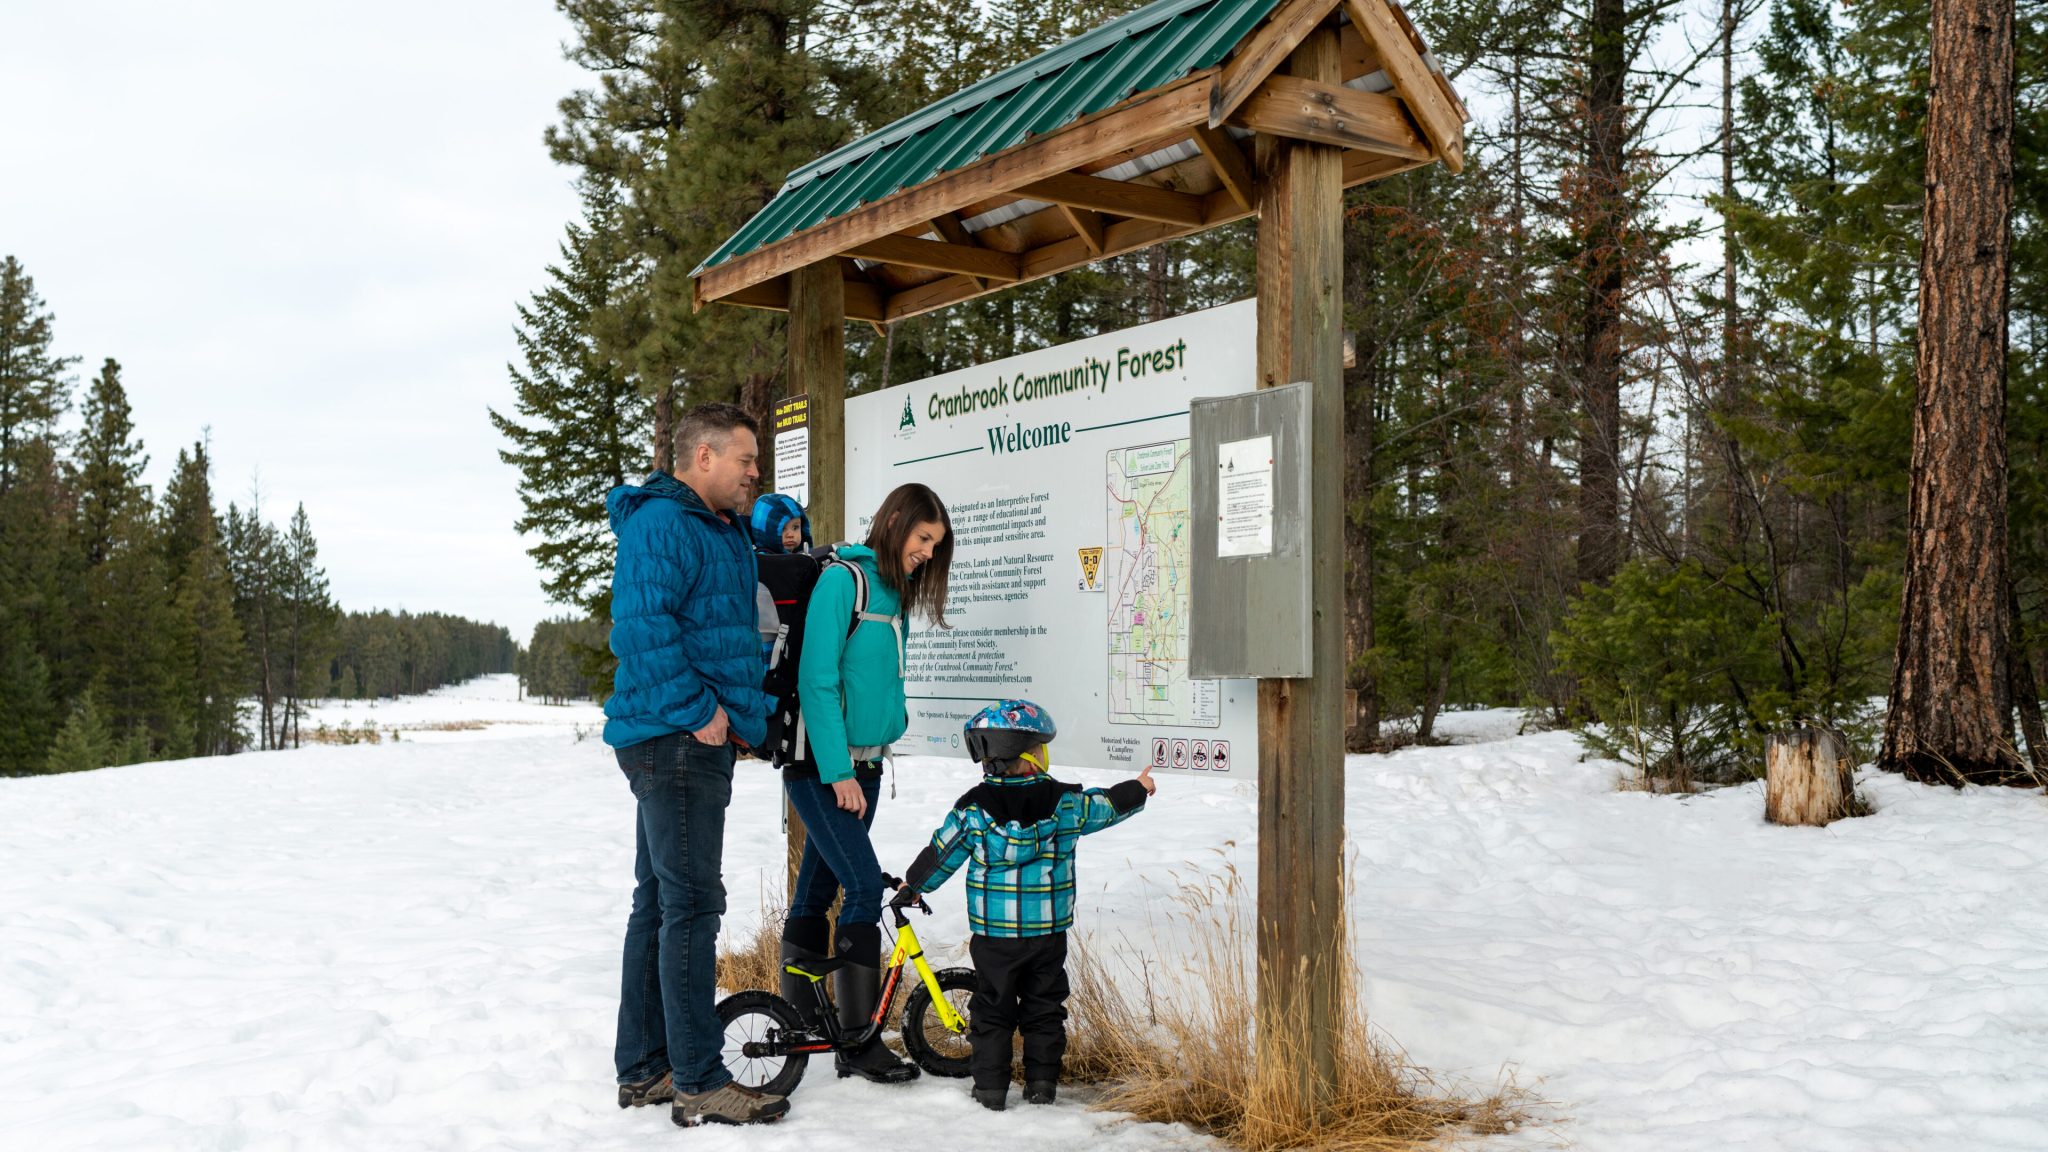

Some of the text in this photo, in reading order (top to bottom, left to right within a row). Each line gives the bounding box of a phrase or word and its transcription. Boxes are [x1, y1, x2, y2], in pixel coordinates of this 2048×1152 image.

[928, 338, 1187, 420] Cranbrook Community Forest
[783, 404, 793, 414] DIRT
[792, 399, 808, 411] TRAILS
[792, 412, 807, 424] TRAILS
[987, 420, 1072, 457] Welcome
[951, 501, 979, 513] designated
[987, 501, 995, 509] an
[996, 495, 1029, 508] Interpretive
[1030, 492, 1050, 503] Forest
[951, 514, 966, 526] enjoy
[973, 514, 988, 523] range
[989, 510, 996, 520] of
[996, 506, 1029, 518] educational
[1030, 504, 1042, 514] and
[971, 520, 1010, 533] environmental
[1011, 517, 1034, 530] impacts
[1034, 516, 1047, 526] and
[955, 530, 1046, 547] in this unique and sensitive area.
[951, 553, 1054, 570] Forests, Lands and Natural Resource
[959, 569, 989, 580] Cranbrook
[989, 566, 1022, 578] Community
[1023, 565, 1042, 575] Forest
[968, 582, 981, 591] with
[981, 580, 1010, 590] assistance
[1010, 578, 1022, 588] and
[1023, 577, 1046, 590] support
[1004, 590, 1029, 602] agencies
[907, 630, 924, 640] upport
[925, 630, 935, 638] this
[952, 628, 969, 640] please
[969, 627, 993, 637] consider
[993, 626, 1029, 638] membership
[1030, 626, 1037, 635] in
[1037, 625, 1048, 635] the
[905, 638, 998, 651] ranbrook Community Forest Society.
[922, 652, 928, 660] to
[927, 651, 937, 660] the
[936, 650, 971, 660] enhancement
[971, 651, 977, 660] &
[977, 650, 1005, 662] protection
[919, 662, 926, 672] of
[925, 662, 934, 671] the
[934, 661, 962, 671] Cranbrook
[962, 661, 994, 673] Community
[926, 710, 945, 719] Sponsors
[1101, 736, 1141, 745] Motorized Vehicles
[1111, 745, 1134, 754] Campfires
[1109, 753, 1132, 762] Prohibited
[875, 946, 905, 1025] NORCO
